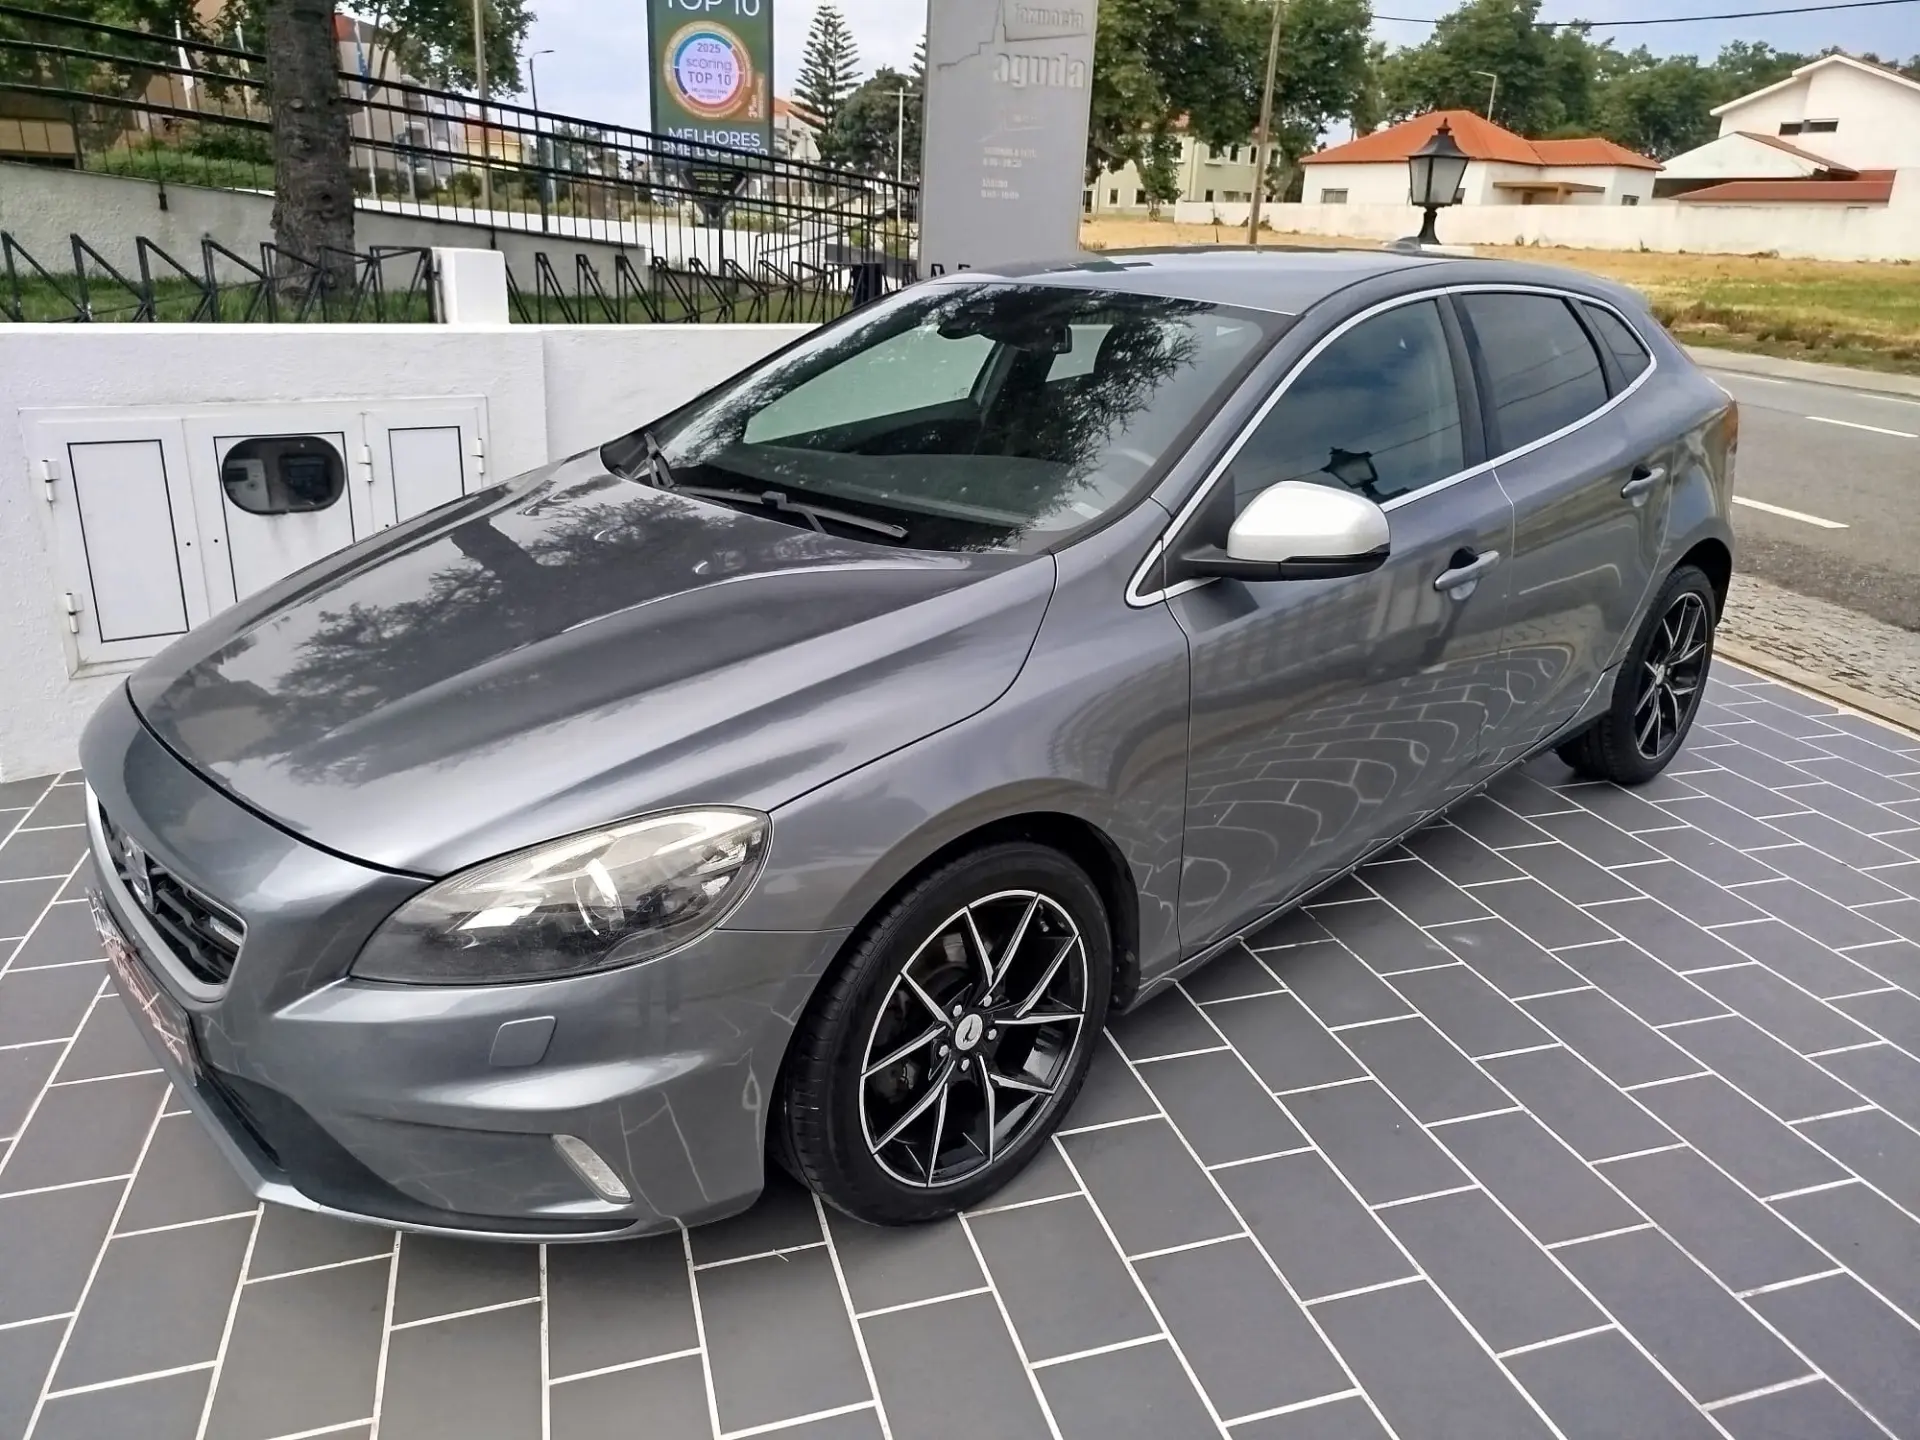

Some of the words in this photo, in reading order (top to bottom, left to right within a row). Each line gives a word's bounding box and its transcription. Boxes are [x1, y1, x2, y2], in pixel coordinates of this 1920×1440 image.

[697, 42, 722, 54] 2025
[687, 70, 713, 85] TOP
[717, 72, 732, 86] 10
[993, 53, 1086, 89] aguda
[668, 127, 761, 147] MELHORES
